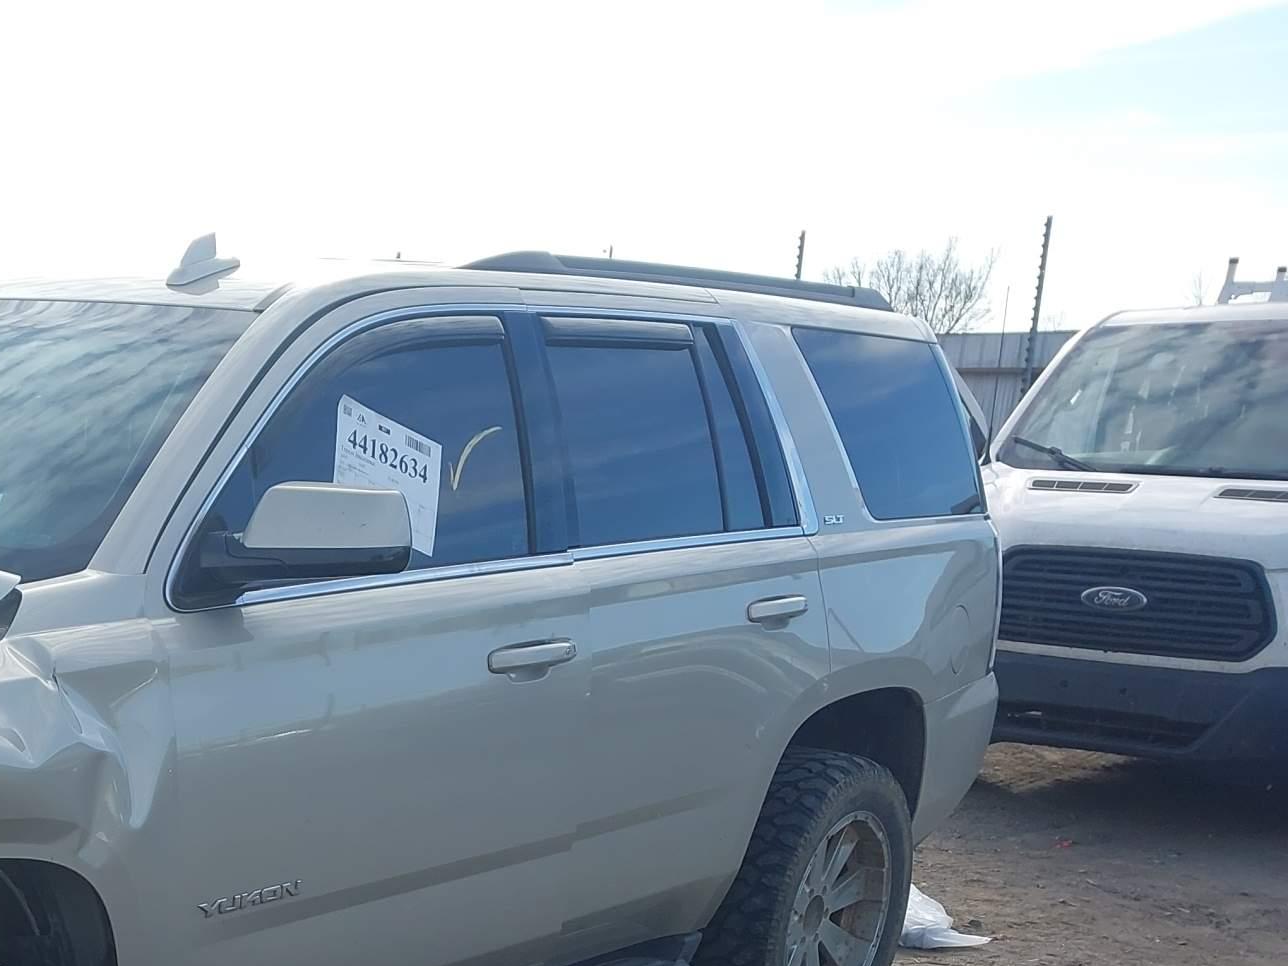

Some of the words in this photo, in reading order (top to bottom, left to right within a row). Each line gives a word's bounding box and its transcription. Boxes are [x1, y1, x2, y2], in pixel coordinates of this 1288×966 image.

[347, 429, 428, 484] 44182634
[823, 514, 844, 525] SLT
[1094, 590, 1130, 607] Ford
[197, 880, 302, 918] YUKON
